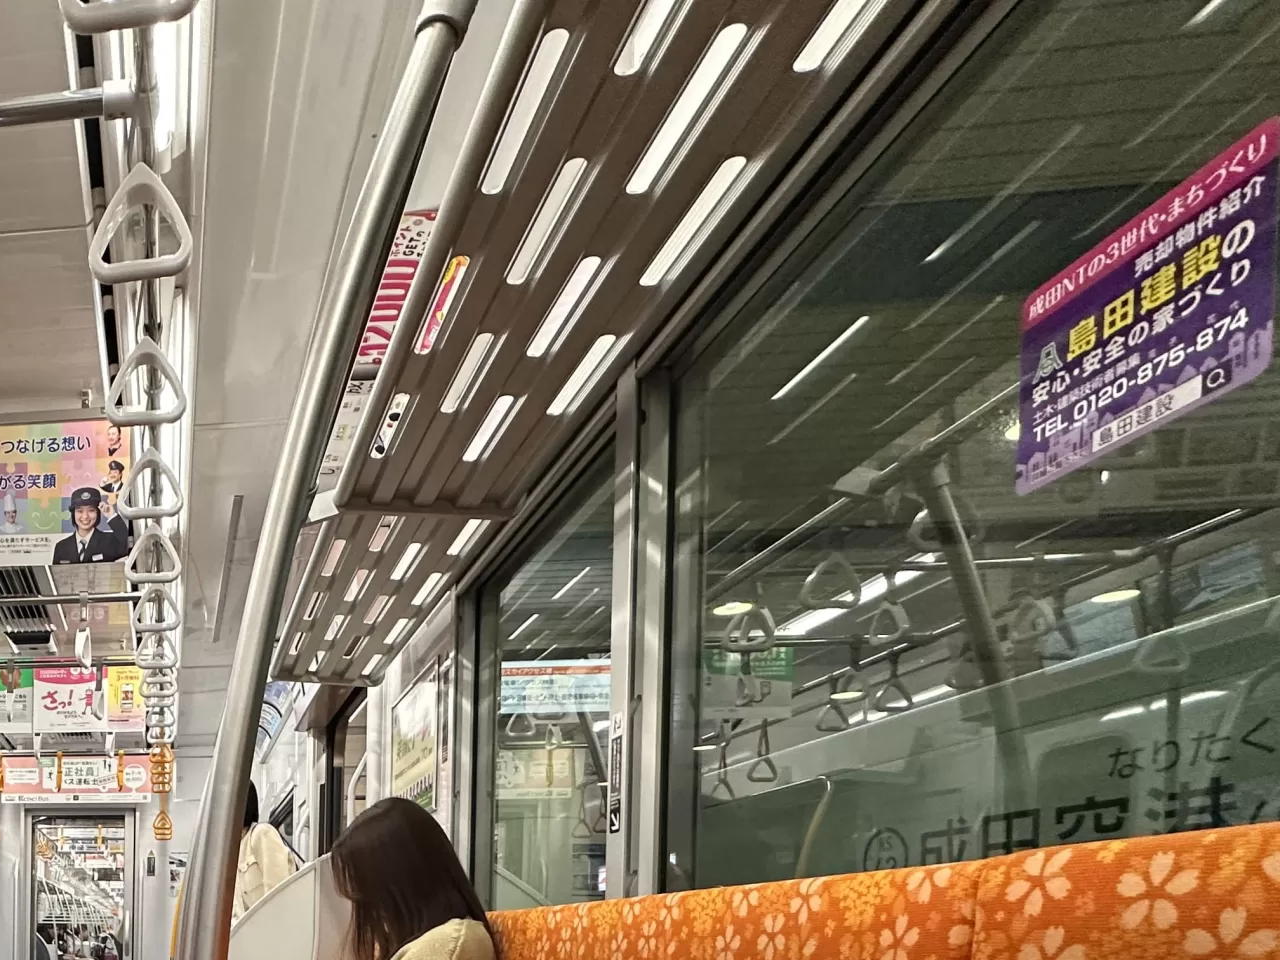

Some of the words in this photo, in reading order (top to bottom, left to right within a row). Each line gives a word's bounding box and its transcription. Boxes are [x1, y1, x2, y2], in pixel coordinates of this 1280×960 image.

[1066, 219, 1256, 361] 島田建設の
[1033, 412, 1069, 443] TEL
[1073, 307, 1249, 421] 0120-875-874
[1, 436, 91, 454] つなげる想い
